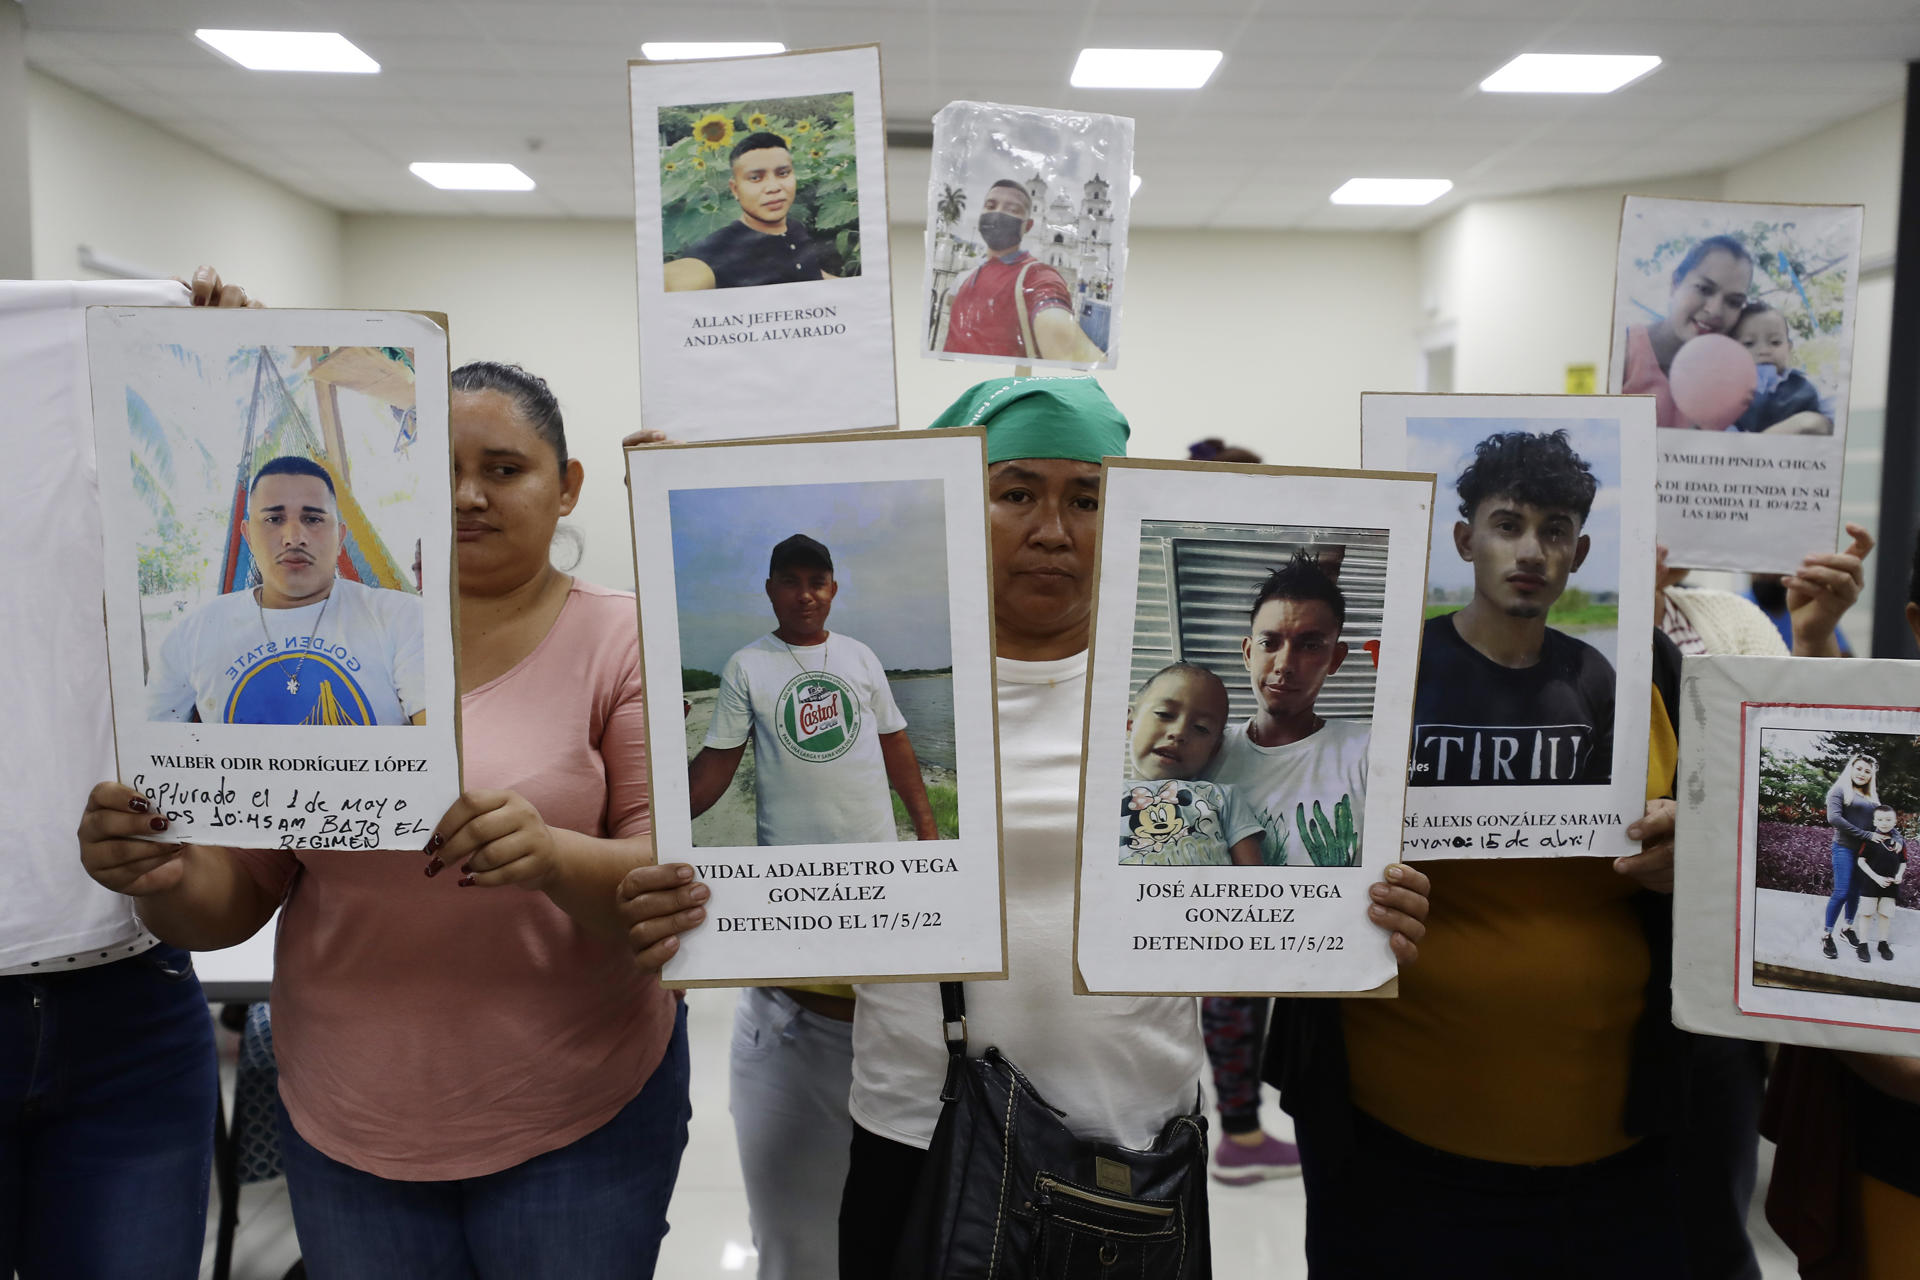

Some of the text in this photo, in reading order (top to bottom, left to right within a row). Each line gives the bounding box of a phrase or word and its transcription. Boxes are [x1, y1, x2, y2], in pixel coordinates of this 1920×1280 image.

[691, 305, 837, 329] ALLAN JEFFERSON
[684, 323, 847, 348] ANDASOL ALVARADO
[1664, 452, 1725, 466] YAMILETH
[1728, 455, 1774, 469] PINEDA
[1779, 459, 1827, 471] CHICAS
[1665, 480, 1680, 491] DE
[1723, 484, 1787, 497] DETENIDA
[1791, 487, 1809, 497] EN
[1813, 488, 1830, 498] SU
[1675, 494, 1690, 505] DE
[1694, 496, 1744, 508] COMIDA
[1749, 499, 1761, 509] EL
[1813, 501, 1821, 512] A
[1682, 508, 1704, 519] LAS
[1730, 511, 1749, 521] PM
[800, 693, 839, 735] Castrol
[150, 755, 428, 772] WALBER ODIR RODRÍGUEZ LÓPEZ
[252, 788, 269, 807] el
[286, 789, 298, 808] 1
[304, 791, 329, 813] de
[319, 815, 380, 837] BAJO
[395, 819, 430, 836] EL
[1423, 815, 1473, 828] ALEXIS
[1477, 812, 1557, 827] GONZÁLEZ
[1560, 813, 1622, 825] SARAVIA
[279, 834, 380, 850] REGIMEN
[1480, 833, 1502, 849] 15
[1505, 829, 1528, 848] de
[1540, 829, 1595, 851] abril
[696, 857, 959, 880] VIDAL ADALBETRO VEGA
[768, 883, 886, 903] GONZÁLEZ
[1136, 880, 1342, 902] JOSÉ ALFREDO VEGA
[717, 911, 942, 933] DETENIDO EL 17/5/22
[1185, 904, 1295, 923] GONZÁLEZ
[1132, 935, 1344, 952] DETENIDO EL 17/5/22
